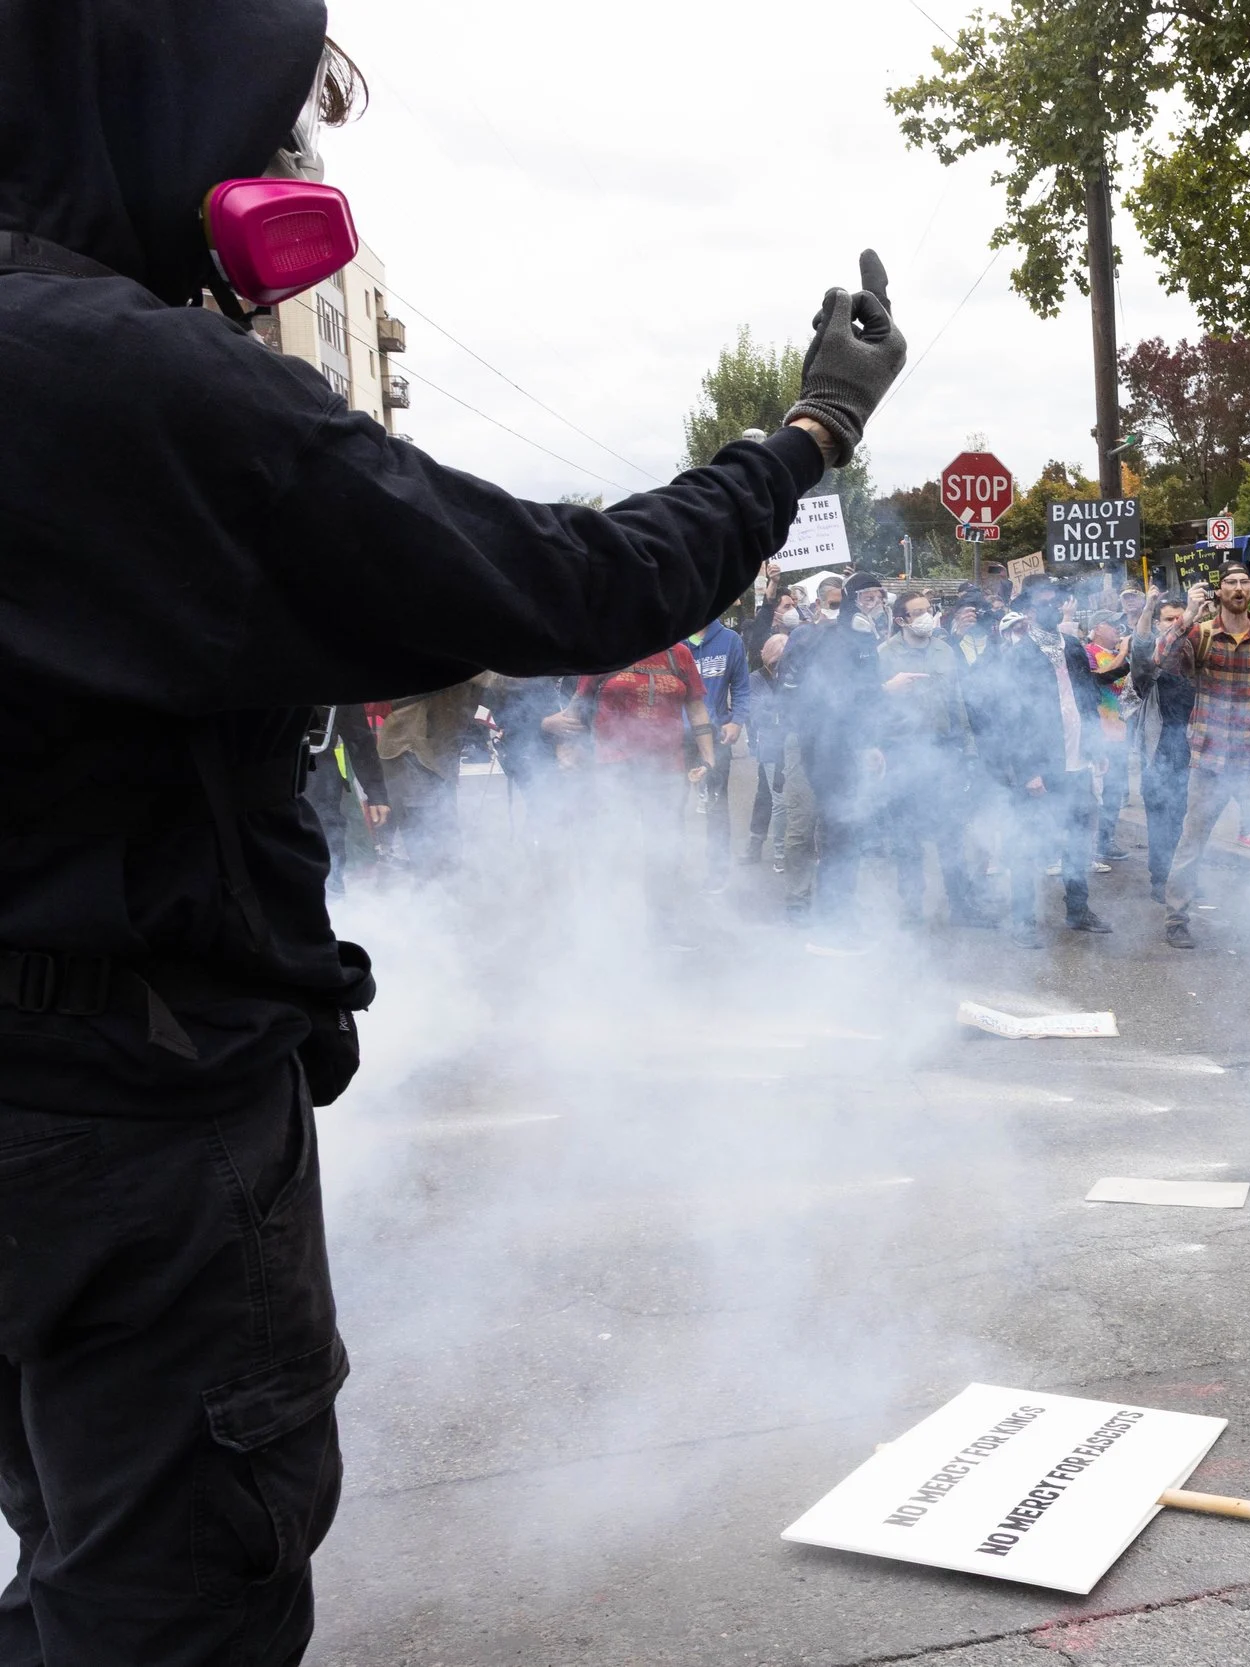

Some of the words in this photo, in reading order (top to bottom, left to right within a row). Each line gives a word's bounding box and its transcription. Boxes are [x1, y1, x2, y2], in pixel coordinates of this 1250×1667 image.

[947, 474, 1008, 501] STOP
[812, 500, 829, 509] THE
[1052, 500, 1135, 521] BALLOTS
[809, 512, 838, 522] FILES!
[1063, 520, 1119, 541] NOT
[771, 547, 810, 561] ABOLISH
[816, 543, 834, 553] ICE!
[1053, 539, 1136, 561] BULLETS
[1013, 556, 1039, 574] END
[883, 1505, 928, 1527] NO
[909, 1456, 980, 1503] MERCY
[960, 1436, 1010, 1457] FOR
[989, 1406, 1046, 1435] KINGS
[974, 1533, 1020, 1557] NO
[997, 1479, 1068, 1532] MERCY
[1045, 1456, 1095, 1481] FOR
[1072, 1410, 1144, 1457] FASCISTS
